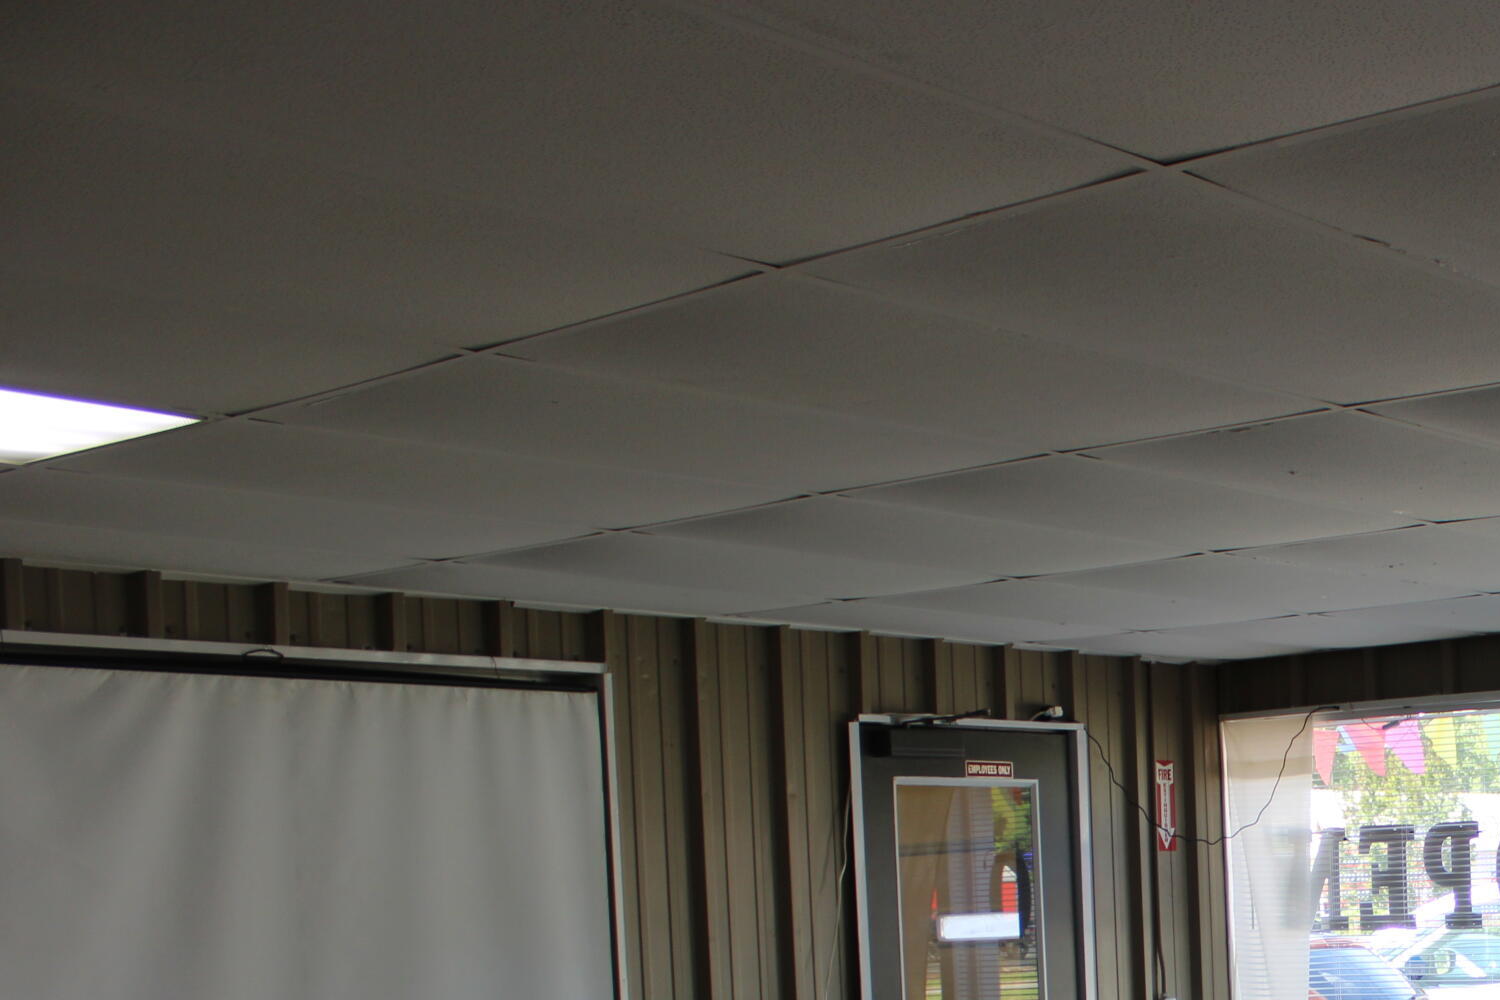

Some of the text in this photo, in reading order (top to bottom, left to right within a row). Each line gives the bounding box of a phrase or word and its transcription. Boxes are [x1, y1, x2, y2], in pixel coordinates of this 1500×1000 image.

[968, 764, 1011, 775] EMPLOYEES ONLY
[1158, 768, 1172, 781] FIRE
